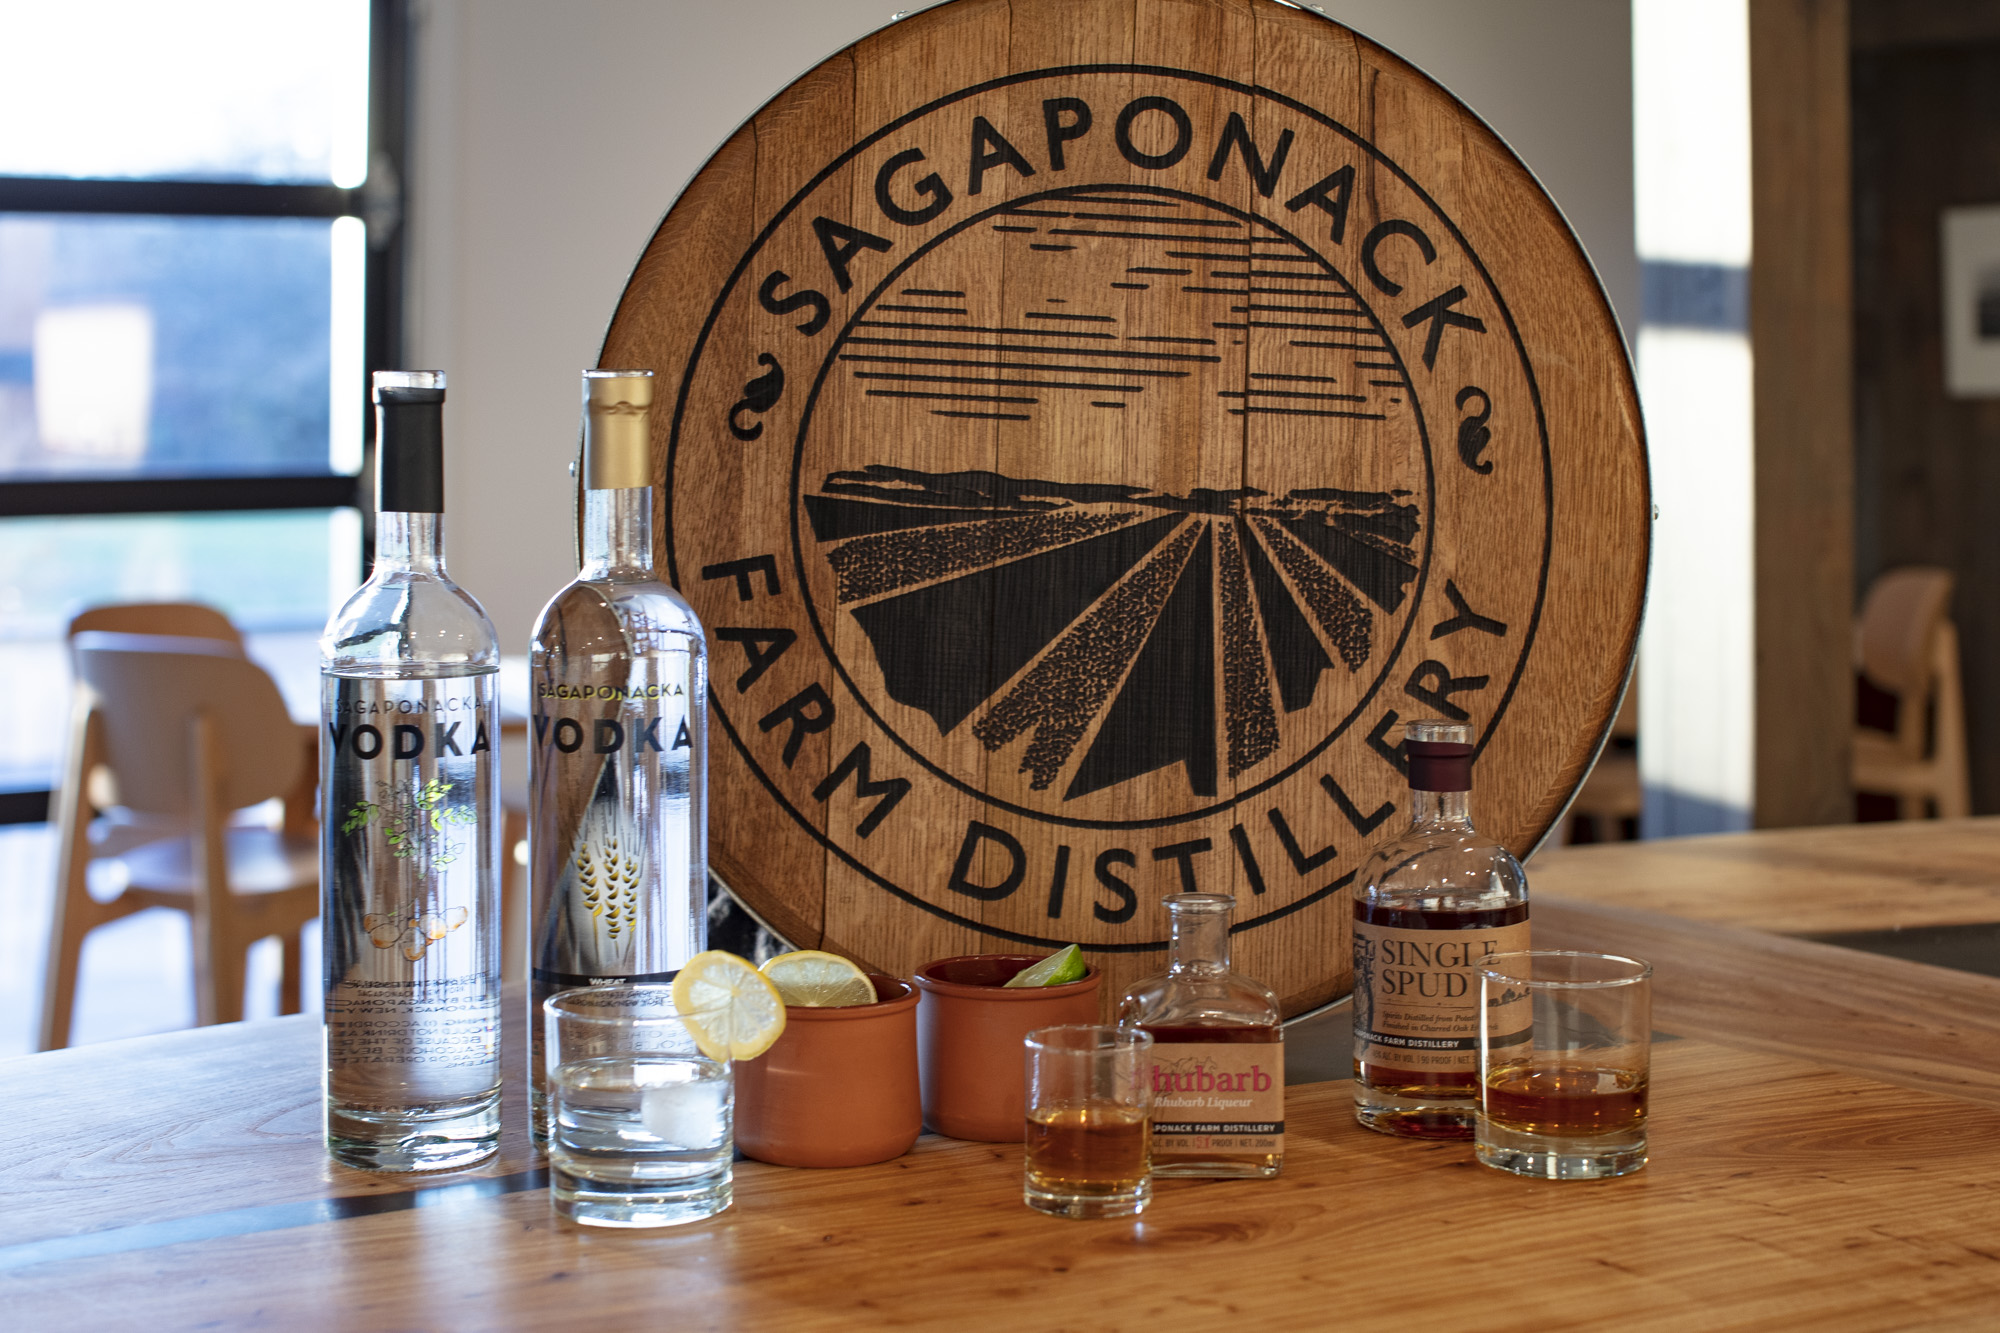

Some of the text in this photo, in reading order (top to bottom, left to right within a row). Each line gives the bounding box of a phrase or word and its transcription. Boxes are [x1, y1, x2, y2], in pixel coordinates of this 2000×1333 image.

[758, 96, 1488, 371] SAGAPONACK
[536, 683, 684, 701] SAGAPONACKA
[336, 696, 484, 714] SAGAPONACKA
[329, 719, 491, 760] VODKA
[533, 714, 693, 754] VODKA
[702, 554, 1508, 923] FARM DISTILLERY
[1381, 939, 1501, 967] SINGLE
[589, 978, 627, 986] WHEAT
[1404, 1013, 1434, 1022] Distilled
[1435, 1014, 1453, 1024] from
[1420, 1024, 1451, 1032] Charred
[1453, 1024, 1469, 1032] Oak
[1384, 1036, 1406, 1046] FARM
[1407, 1039, 1460, 1048] DISTILLERY
[1154, 1097, 1253, 1110] Rhubarb Liqueur
[1194, 1124, 1220, 1132] FARM
[1223, 1124, 1275, 1132] DISTILLERY
